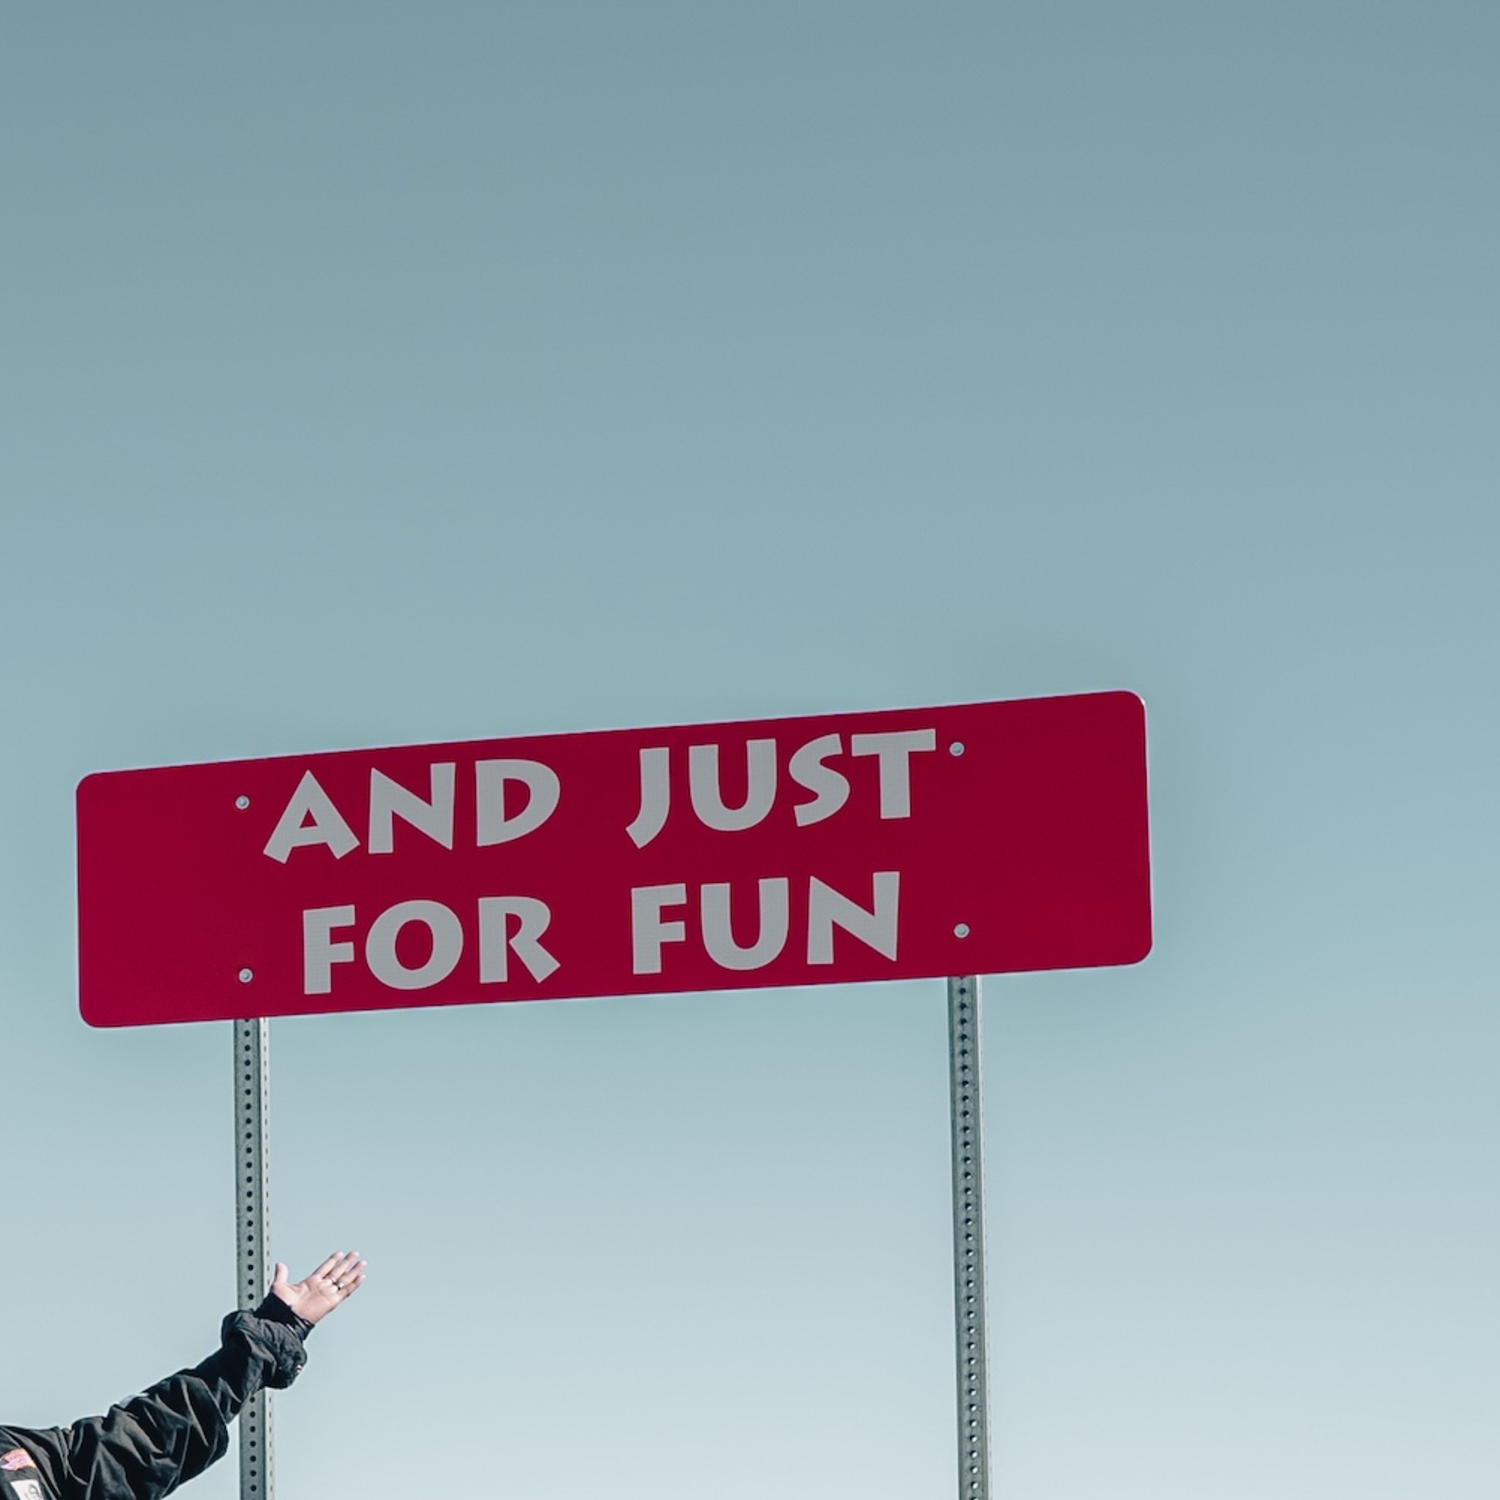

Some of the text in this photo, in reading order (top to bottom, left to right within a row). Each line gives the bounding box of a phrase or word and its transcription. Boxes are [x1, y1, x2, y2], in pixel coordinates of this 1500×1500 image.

[263, 728, 936, 864] AND JUST
[303, 871, 900, 995] FOR FUN
